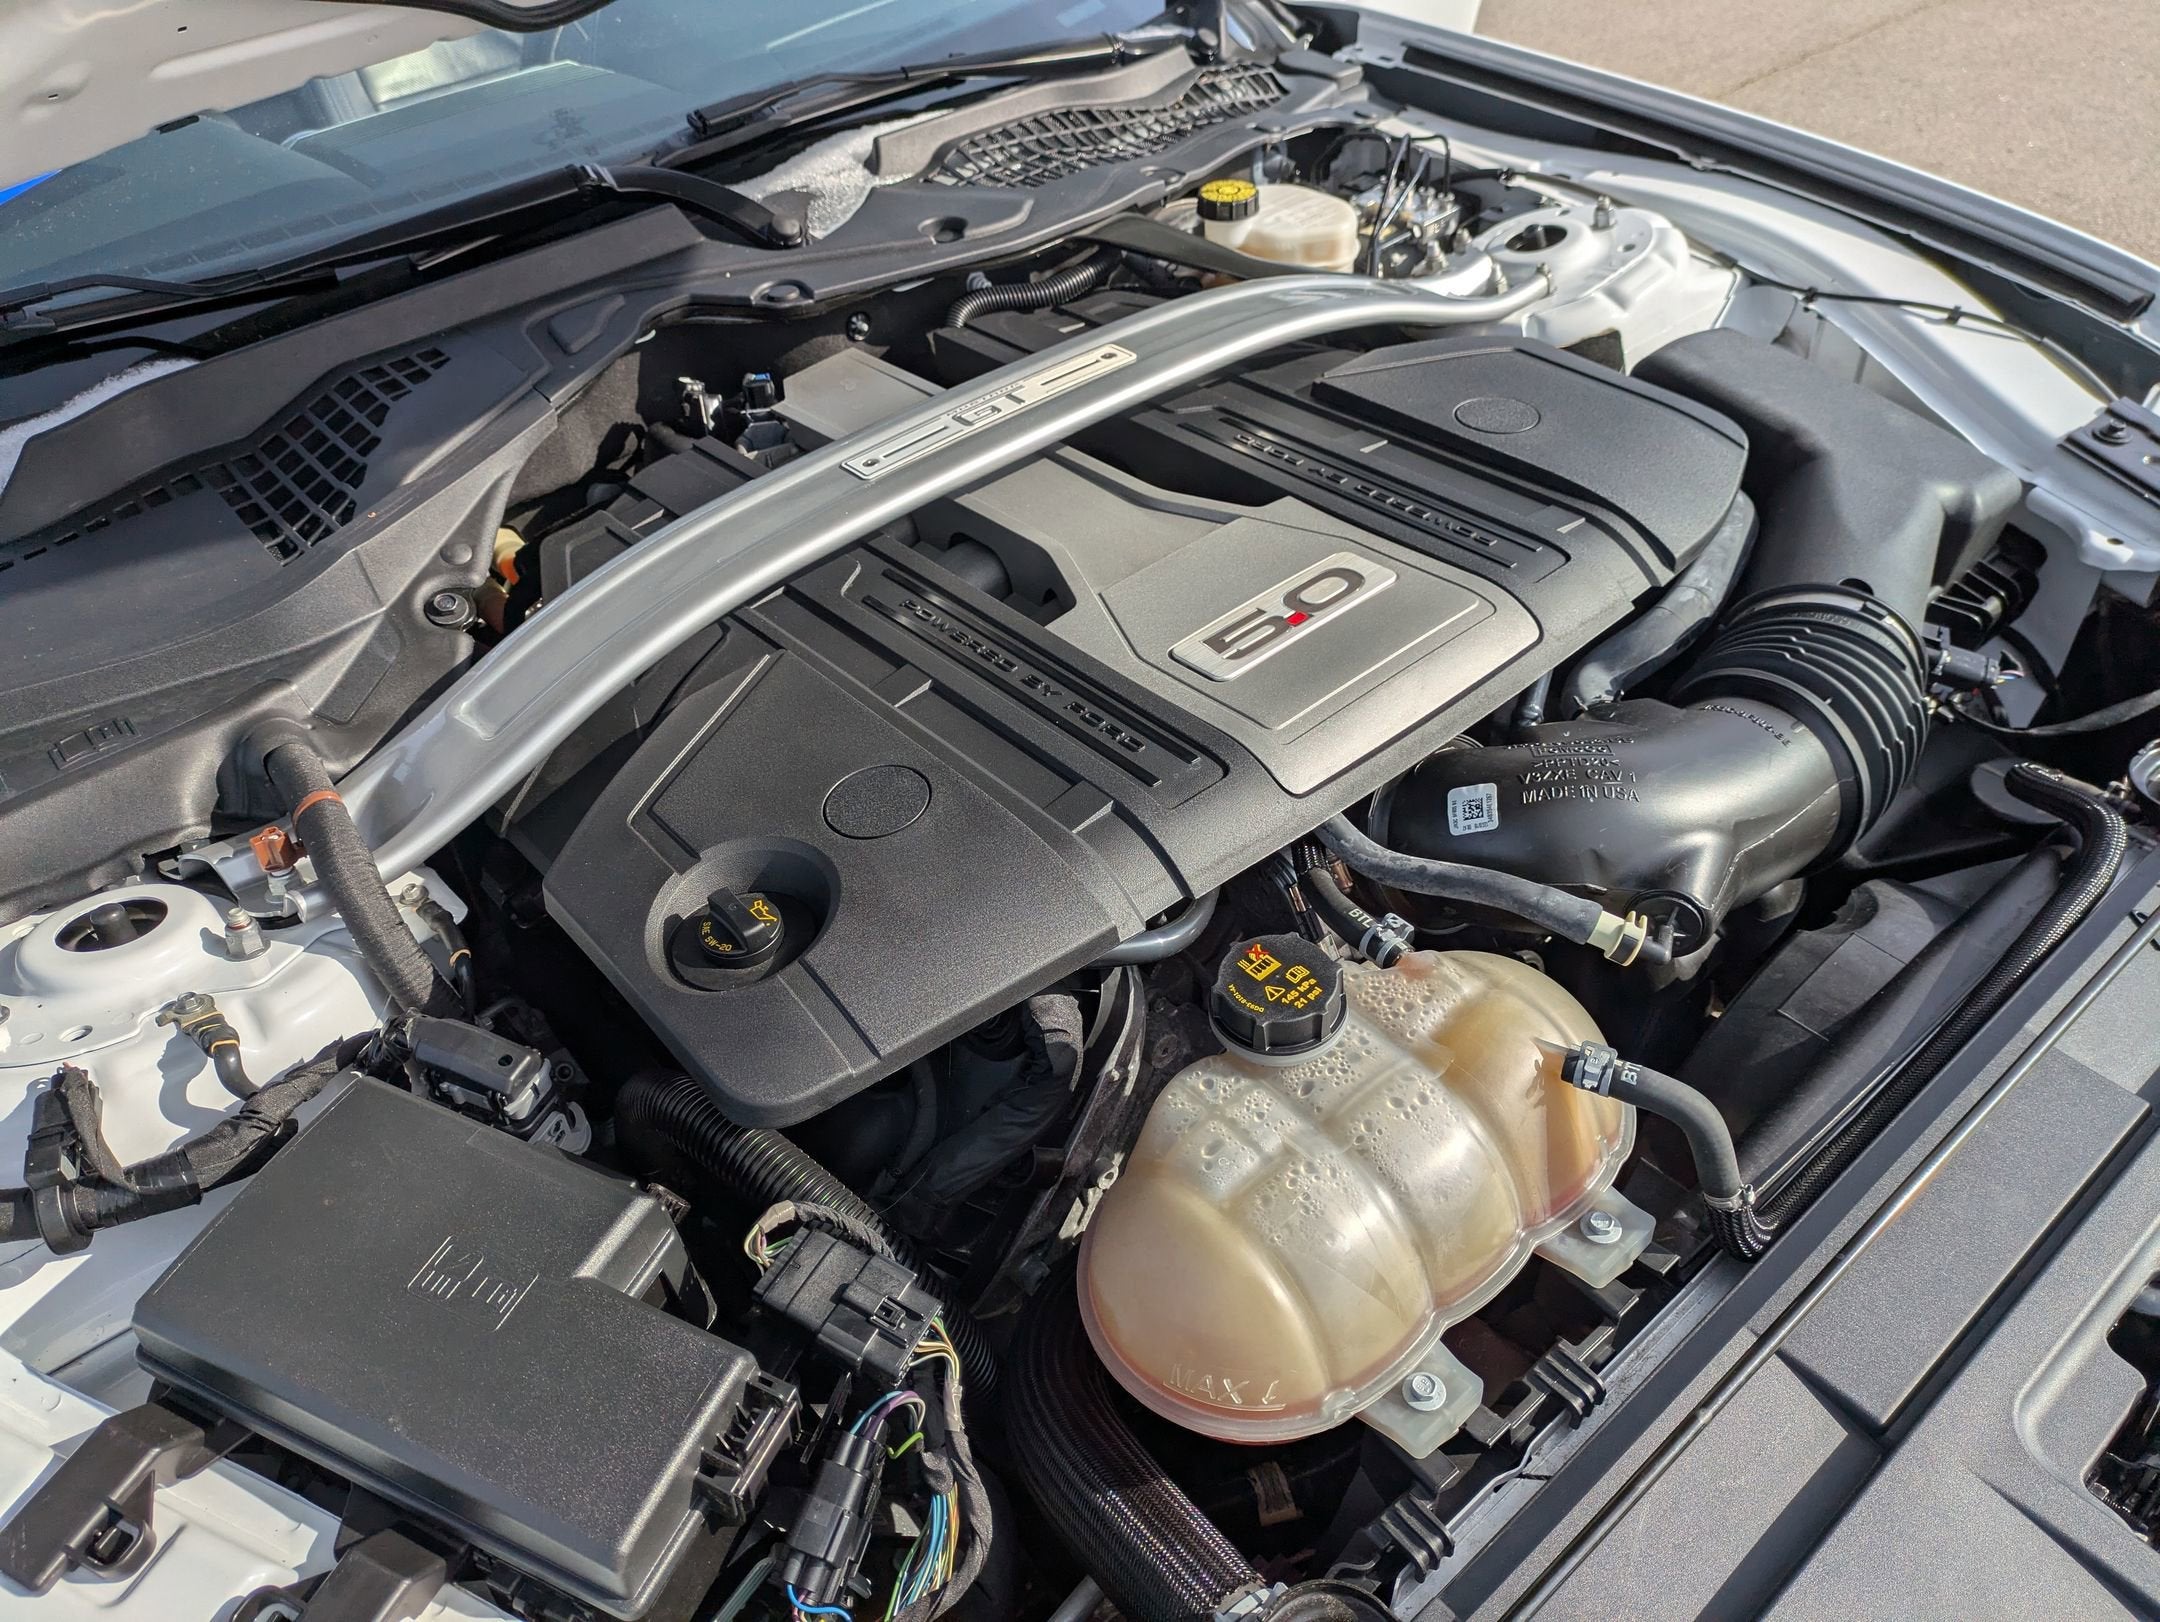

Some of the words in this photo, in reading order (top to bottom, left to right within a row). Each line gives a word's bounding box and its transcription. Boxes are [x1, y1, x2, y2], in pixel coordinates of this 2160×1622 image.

[952, 385, 1025, 426] GT
[1200, 567, 1366, 660] 5.0
[900, 600, 1018, 672] POWERED
[1020, 674, 1062, 697] BY
[1063, 702, 1146, 753] FORD
[1585, 769, 1623, 782] CAV
[1522, 785, 1576, 804] MADE
[1579, 785, 1598, 799] IN
[1603, 786, 1640, 803] USA
[702, 921, 712, 935] SAE
[1348, 908, 1373, 928] BTL
[704, 936, 732, 952] 5W-20
[1281, 990, 1300, 1004] 145
[1296, 978, 1317, 993] kPa
[1293, 997, 1308, 1009] 21
[1306, 986, 1323, 1001] psi
[1169, 1364, 1250, 1404] MAX
